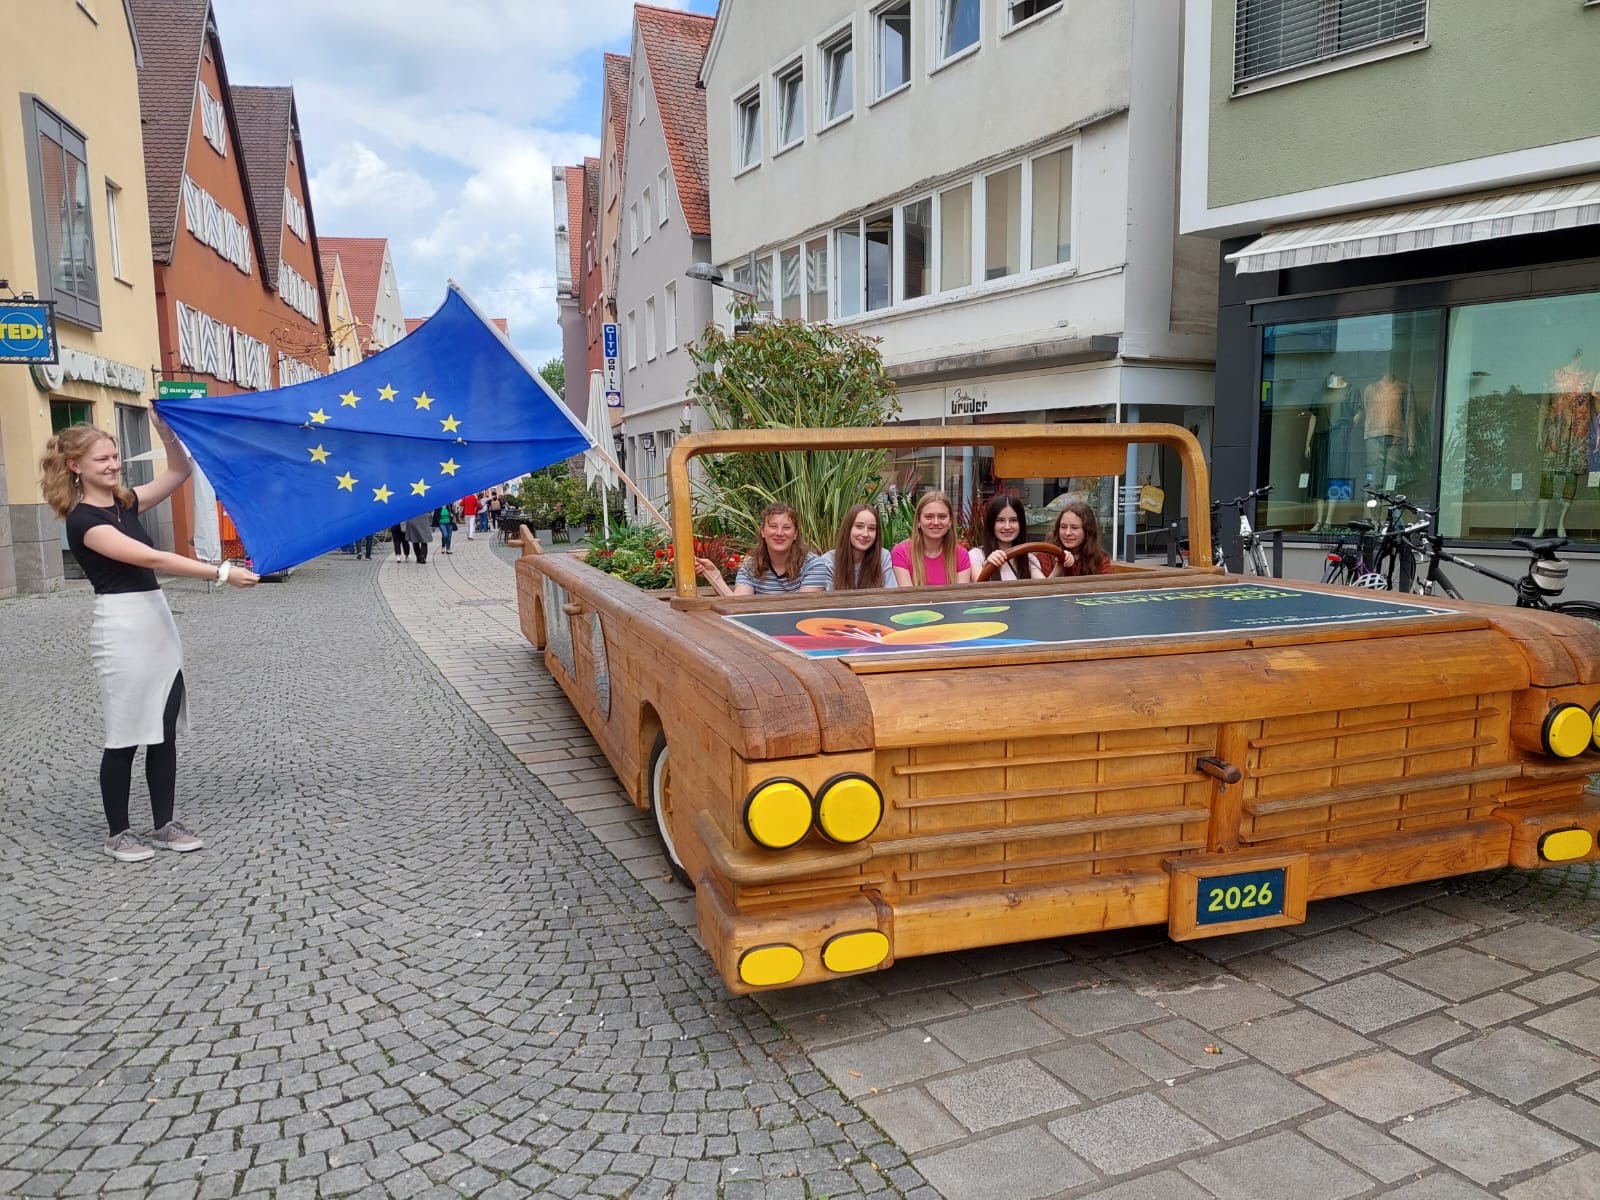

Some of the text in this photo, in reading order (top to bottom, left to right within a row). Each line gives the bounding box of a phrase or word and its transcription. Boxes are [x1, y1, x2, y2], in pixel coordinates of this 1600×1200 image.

[0, 323, 44, 340] TEDi
[605, 326, 615, 356] CITY
[607, 358, 616, 391] GRILL
[1208, 882, 1273, 912] 2026
